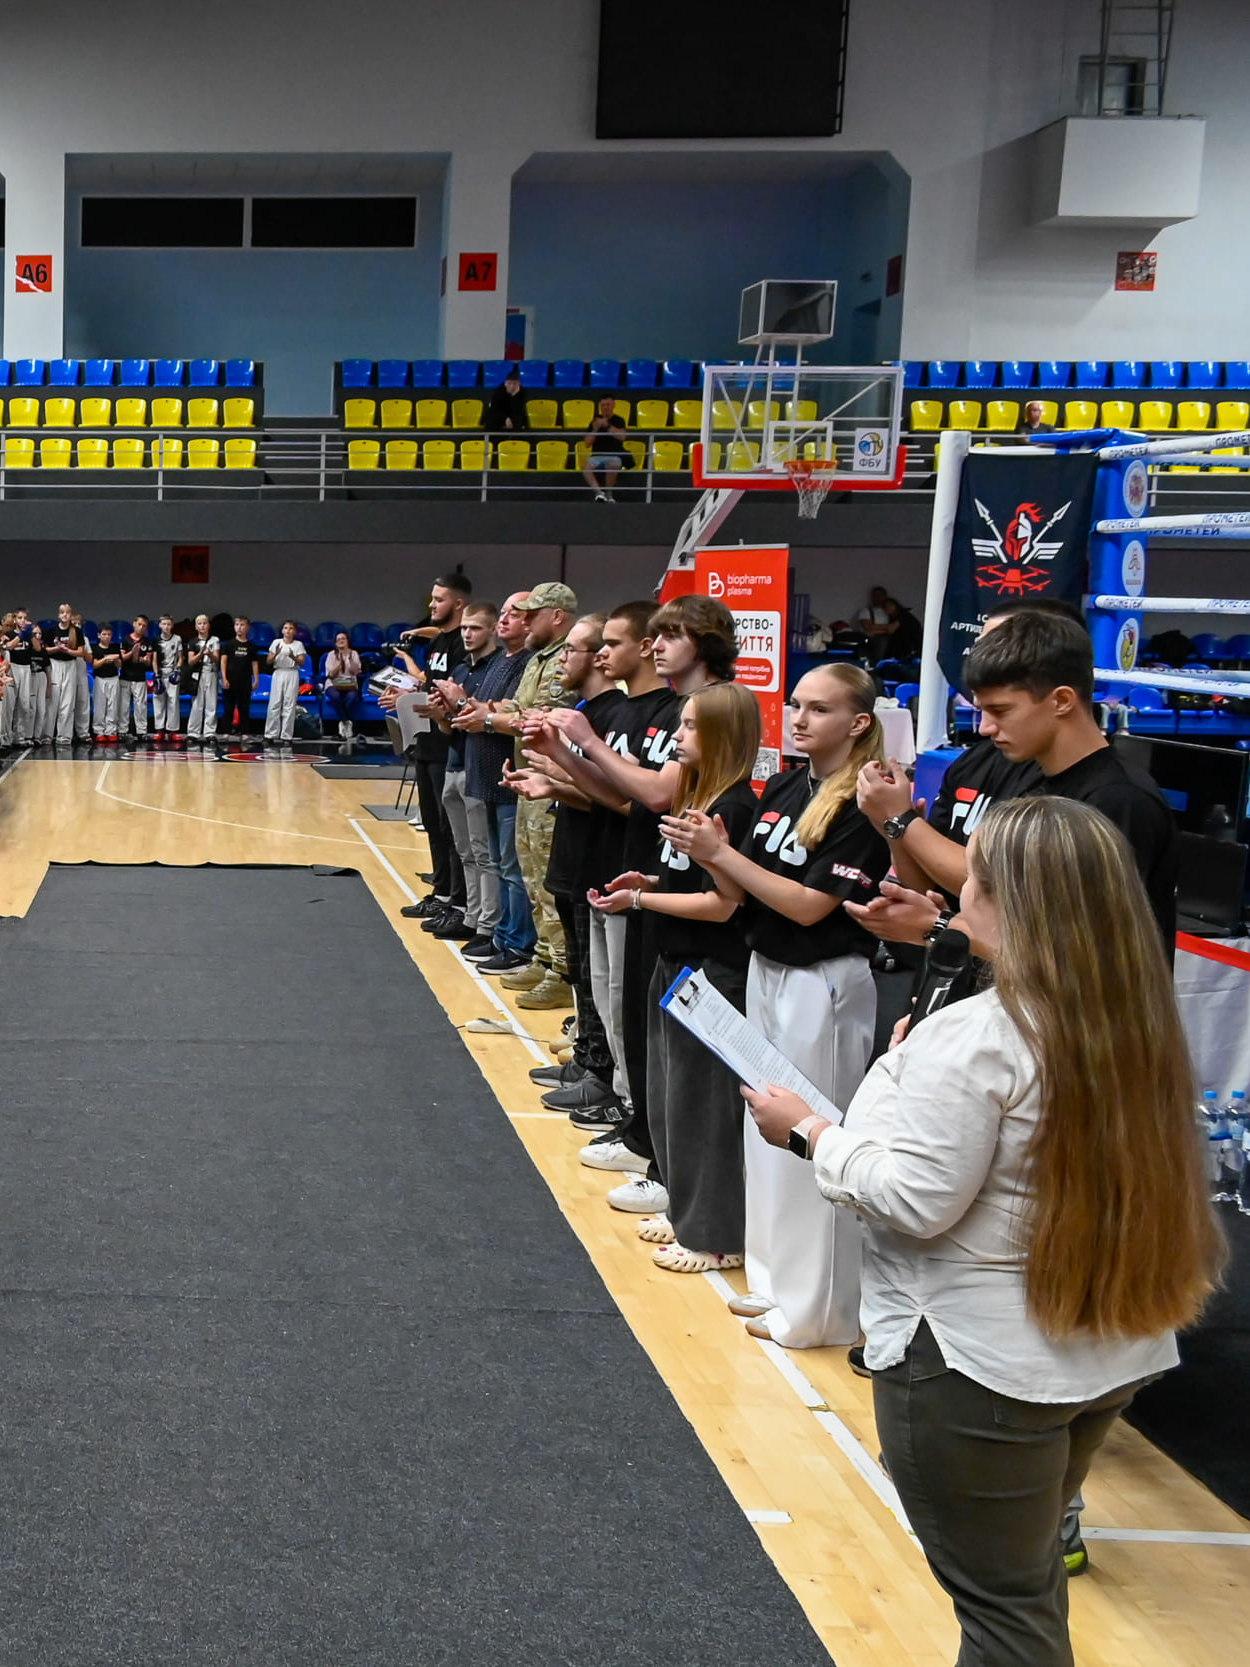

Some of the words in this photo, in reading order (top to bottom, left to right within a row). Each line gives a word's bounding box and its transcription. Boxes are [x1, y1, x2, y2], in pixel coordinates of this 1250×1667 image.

[858, 458, 881, 469] ФБУ
[727, 574, 772, 586] biopharma
[727, 587, 753, 597] plasma
[1206, 598, 1250, 609] ПРОМЕТЕ
[734, 618, 774, 631] РСТВО-
[737, 635, 773, 652] ИТТЯ
